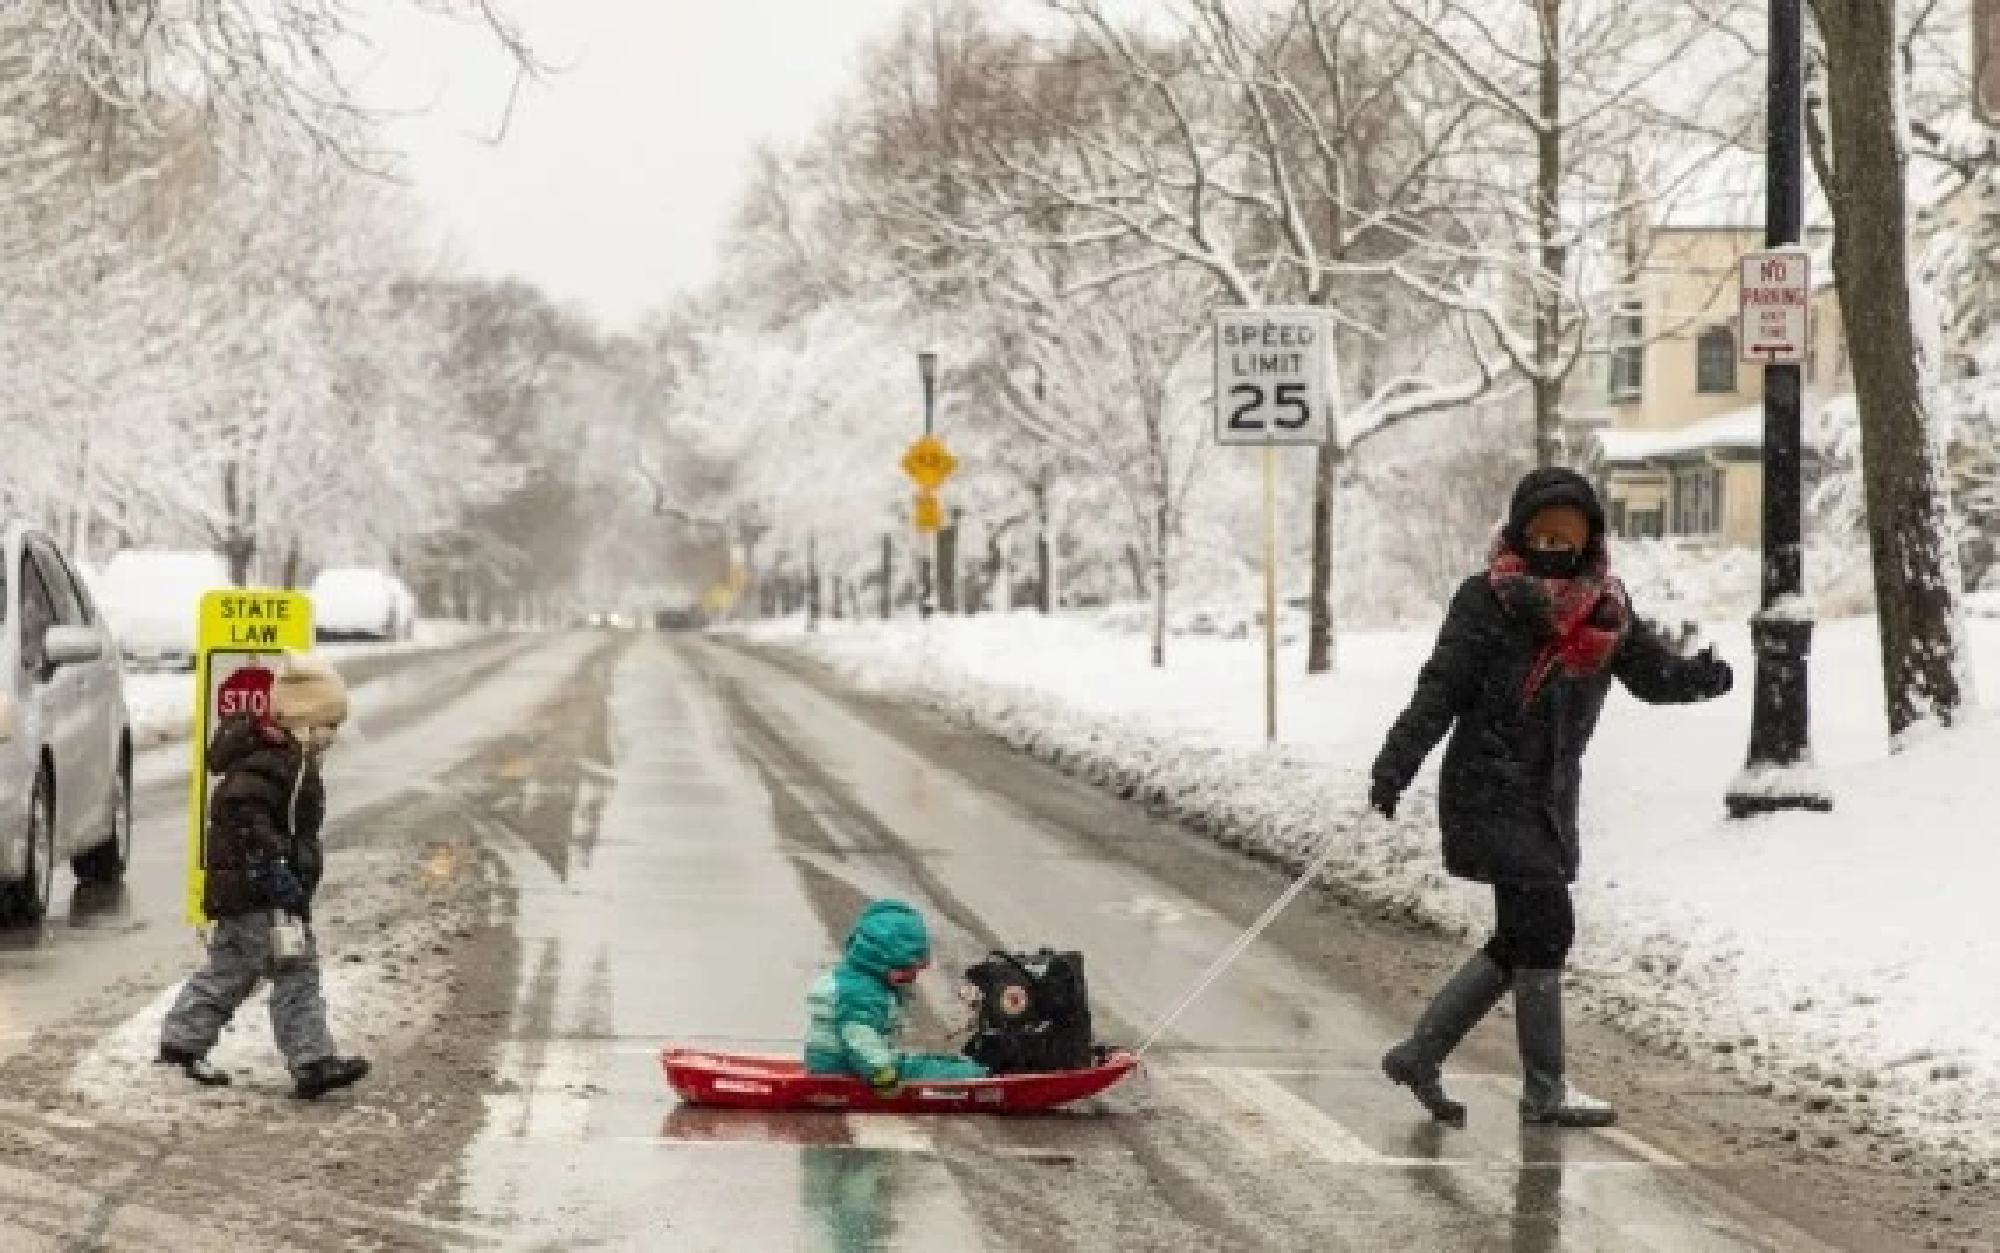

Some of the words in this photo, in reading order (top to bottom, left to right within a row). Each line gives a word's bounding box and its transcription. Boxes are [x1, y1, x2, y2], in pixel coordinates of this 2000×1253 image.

[1761, 260, 1786, 281] NO
[1741, 288, 1807, 308] PARKING
[1225, 325, 1316, 347] SPEED
[1232, 353, 1302, 376] LIMIT
[1228, 383, 1310, 431] 25
[220, 597, 292, 621] STATE
[231, 624, 278, 643] LAW
[220, 690, 268, 716] STO
